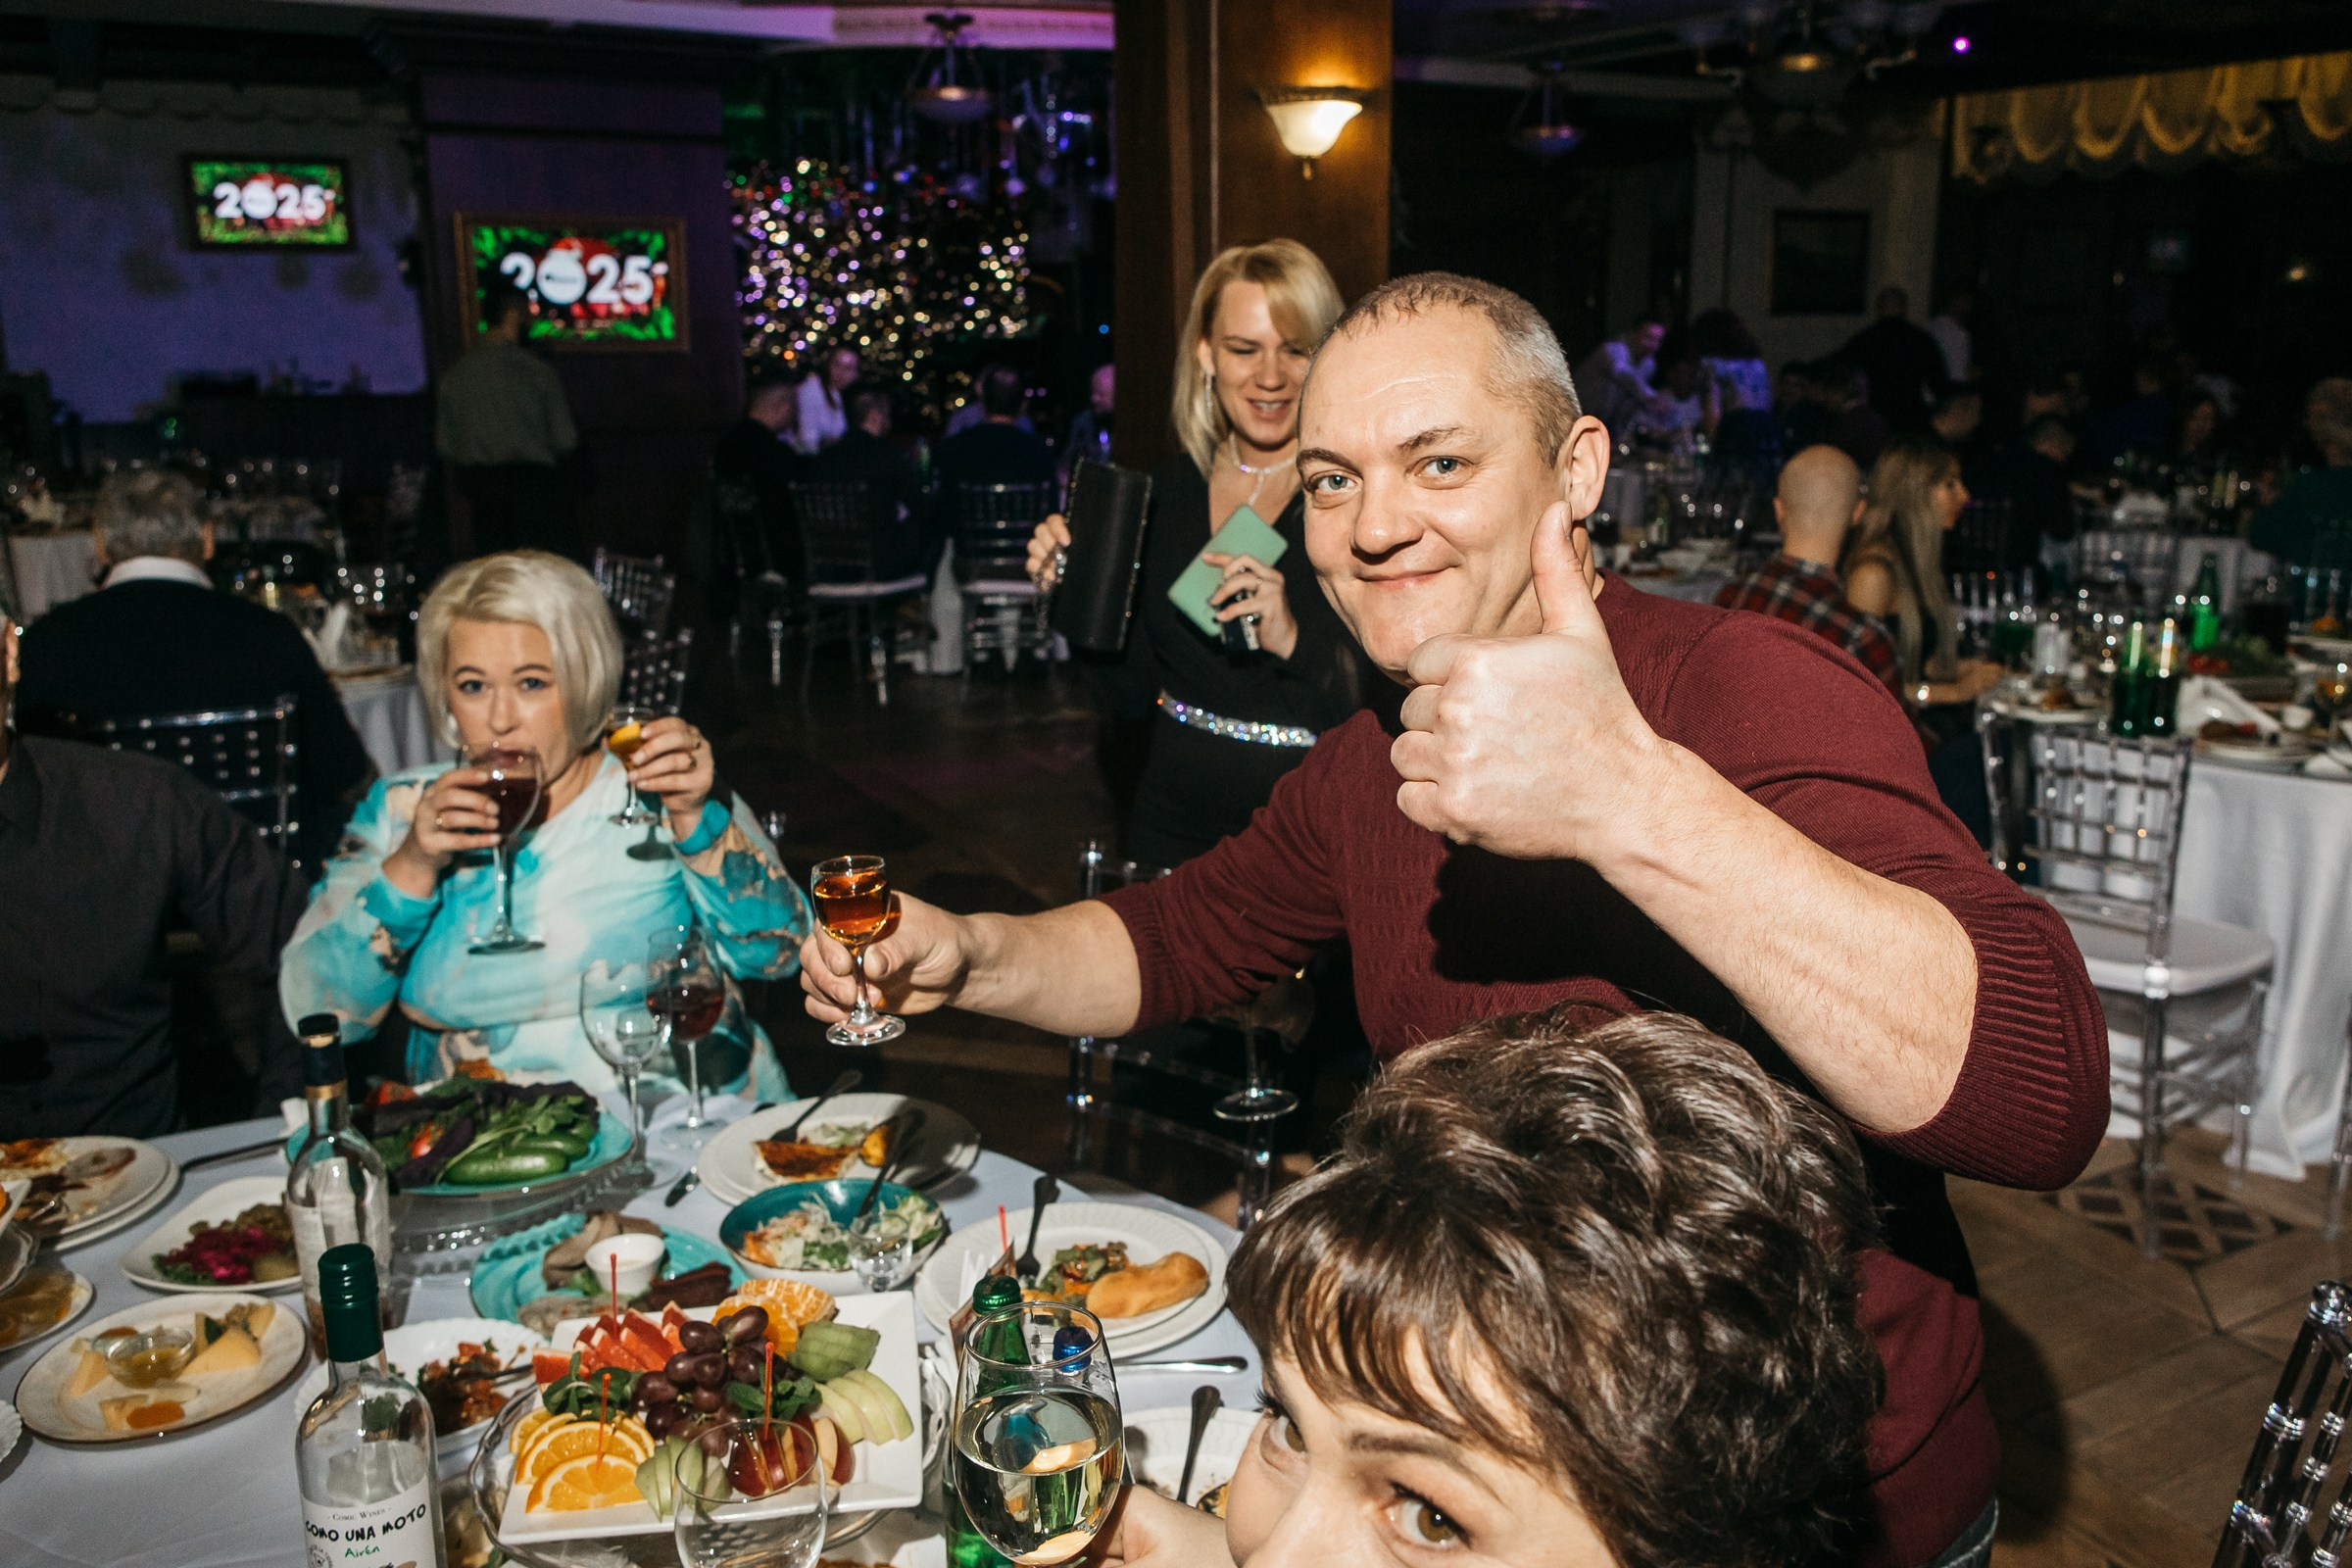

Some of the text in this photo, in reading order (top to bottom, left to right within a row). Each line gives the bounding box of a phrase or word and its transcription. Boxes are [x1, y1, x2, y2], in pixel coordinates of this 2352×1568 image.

[213, 180, 327, 220] 2025
[305, 1503, 426, 1542] COMO UNA MOTO
